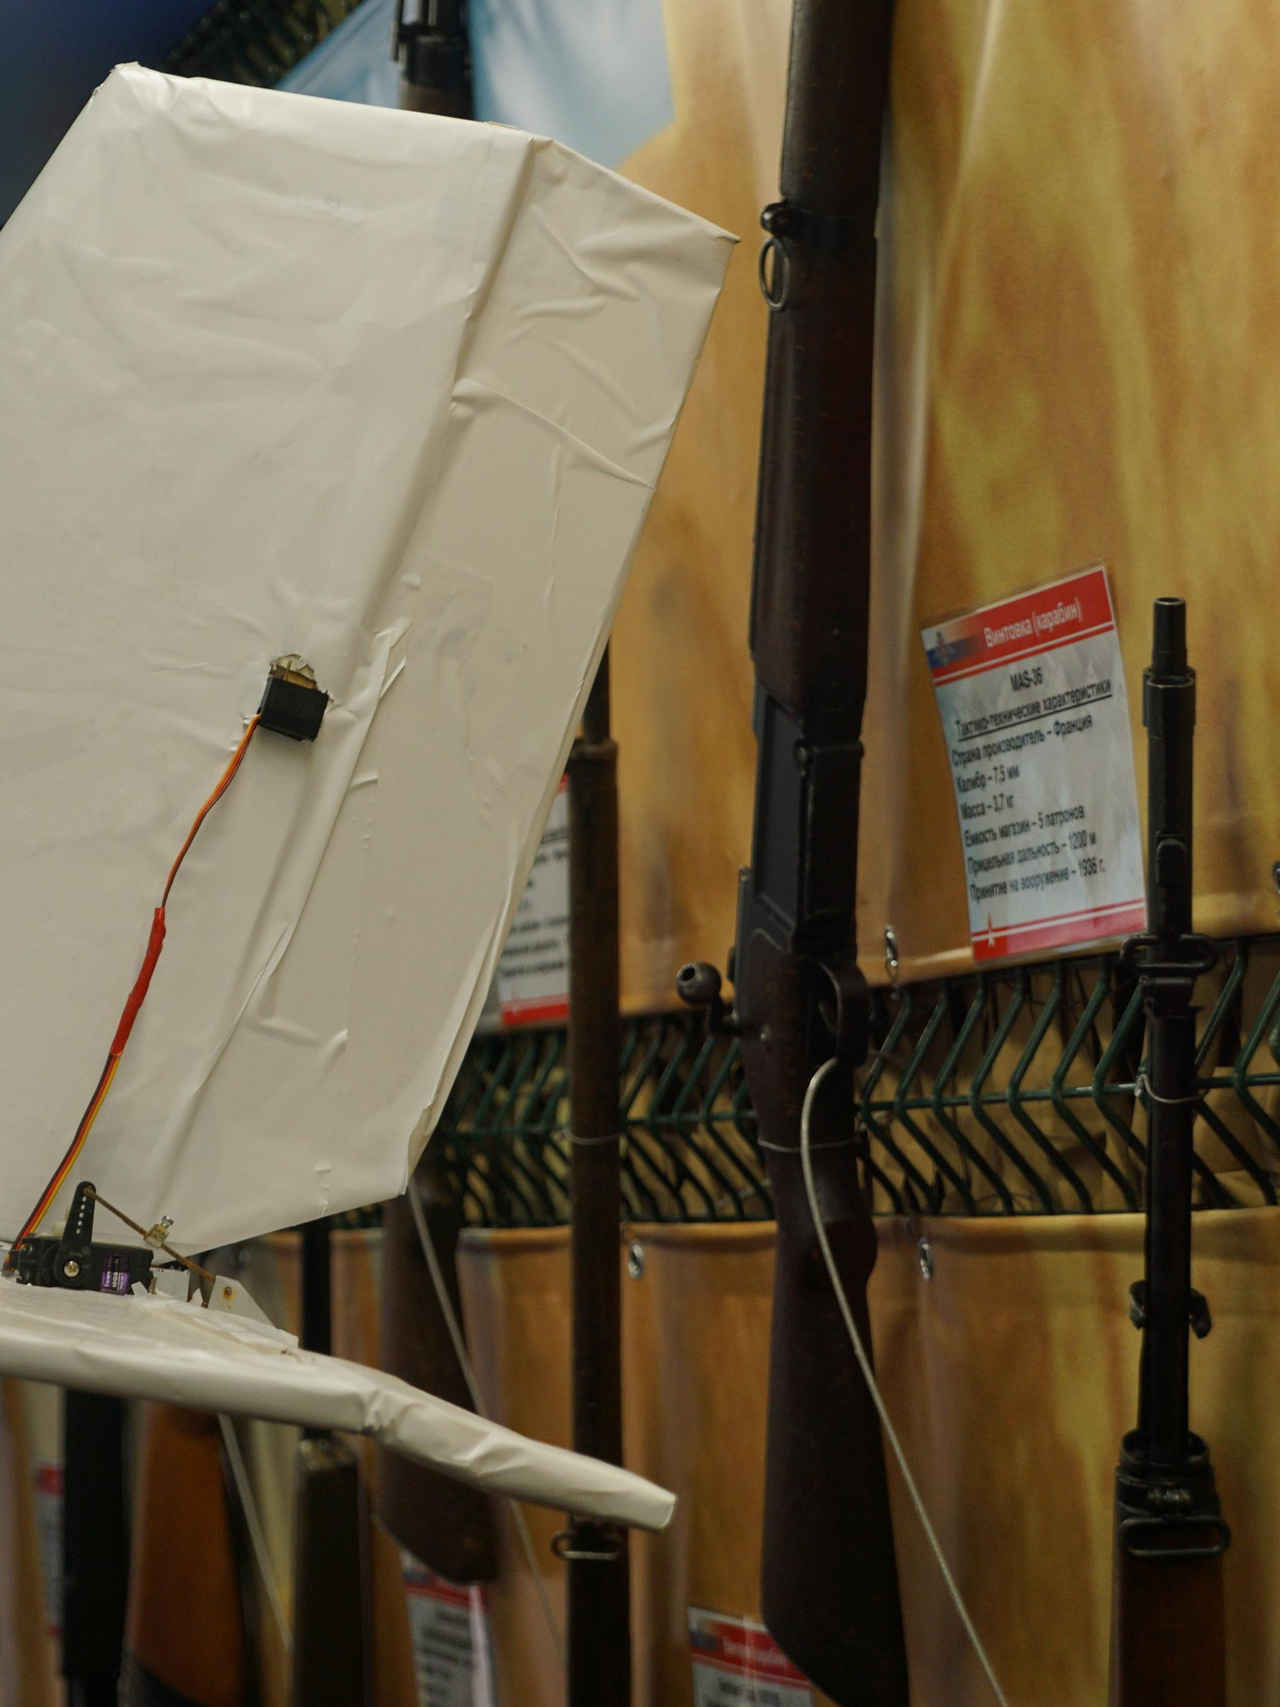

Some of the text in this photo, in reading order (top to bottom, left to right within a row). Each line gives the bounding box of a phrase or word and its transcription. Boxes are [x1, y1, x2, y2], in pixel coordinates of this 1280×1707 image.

[984, 598, 1081, 647] Винтовка (карабин)
[1010, 667, 1043, 692] MAS-36
[1043, 678, 1112, 712] характеристики
[951, 747, 982, 768] Страна
[983, 731, 1045, 762] производитель
[1053, 713, 1093, 742] Франция
[956, 770, 987, 793] Калибр
[960, 802, 986, 821] Масса
[1045, 805, 1085, 828] патронов
